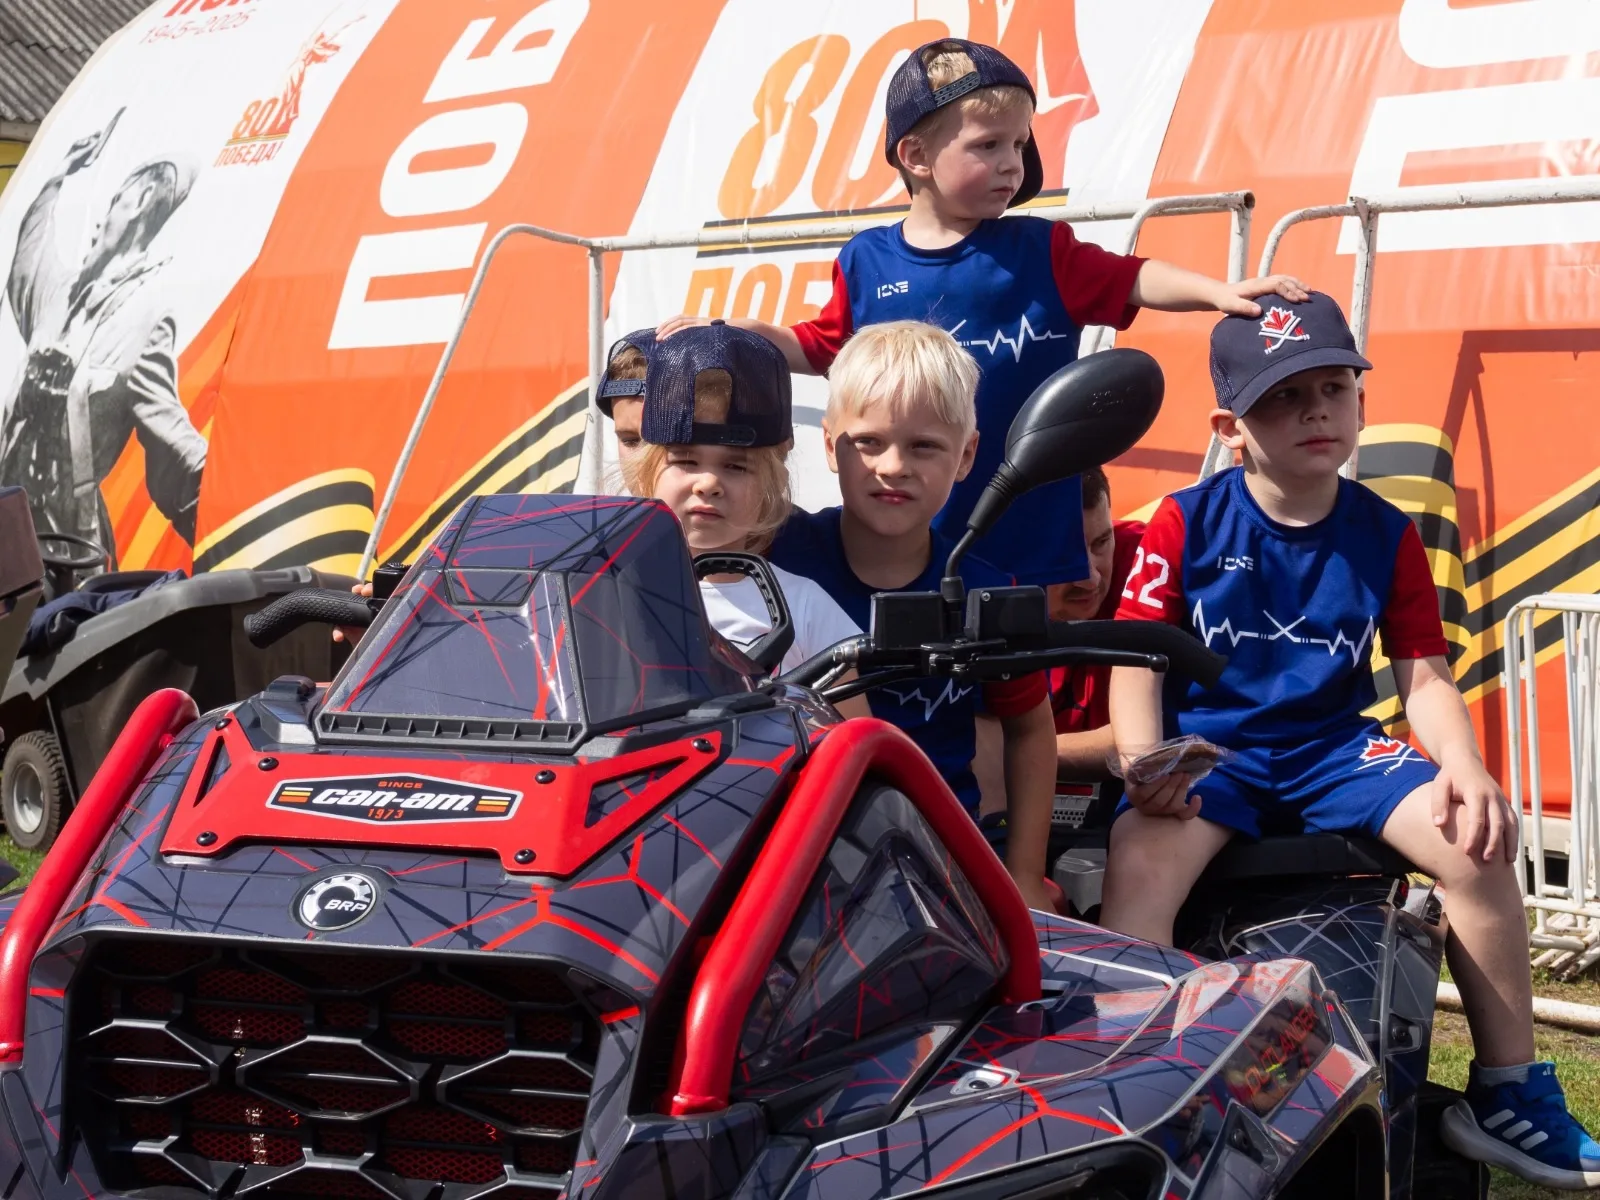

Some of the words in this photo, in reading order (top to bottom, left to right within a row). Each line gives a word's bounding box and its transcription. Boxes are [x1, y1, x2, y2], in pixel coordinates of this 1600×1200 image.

[231, 97, 280, 140] 80
[1121, 545, 1170, 609] 22
[377, 780, 424, 790] SINCE
[367, 807, 405, 821] 1973
[323, 898, 368, 912] BRP
